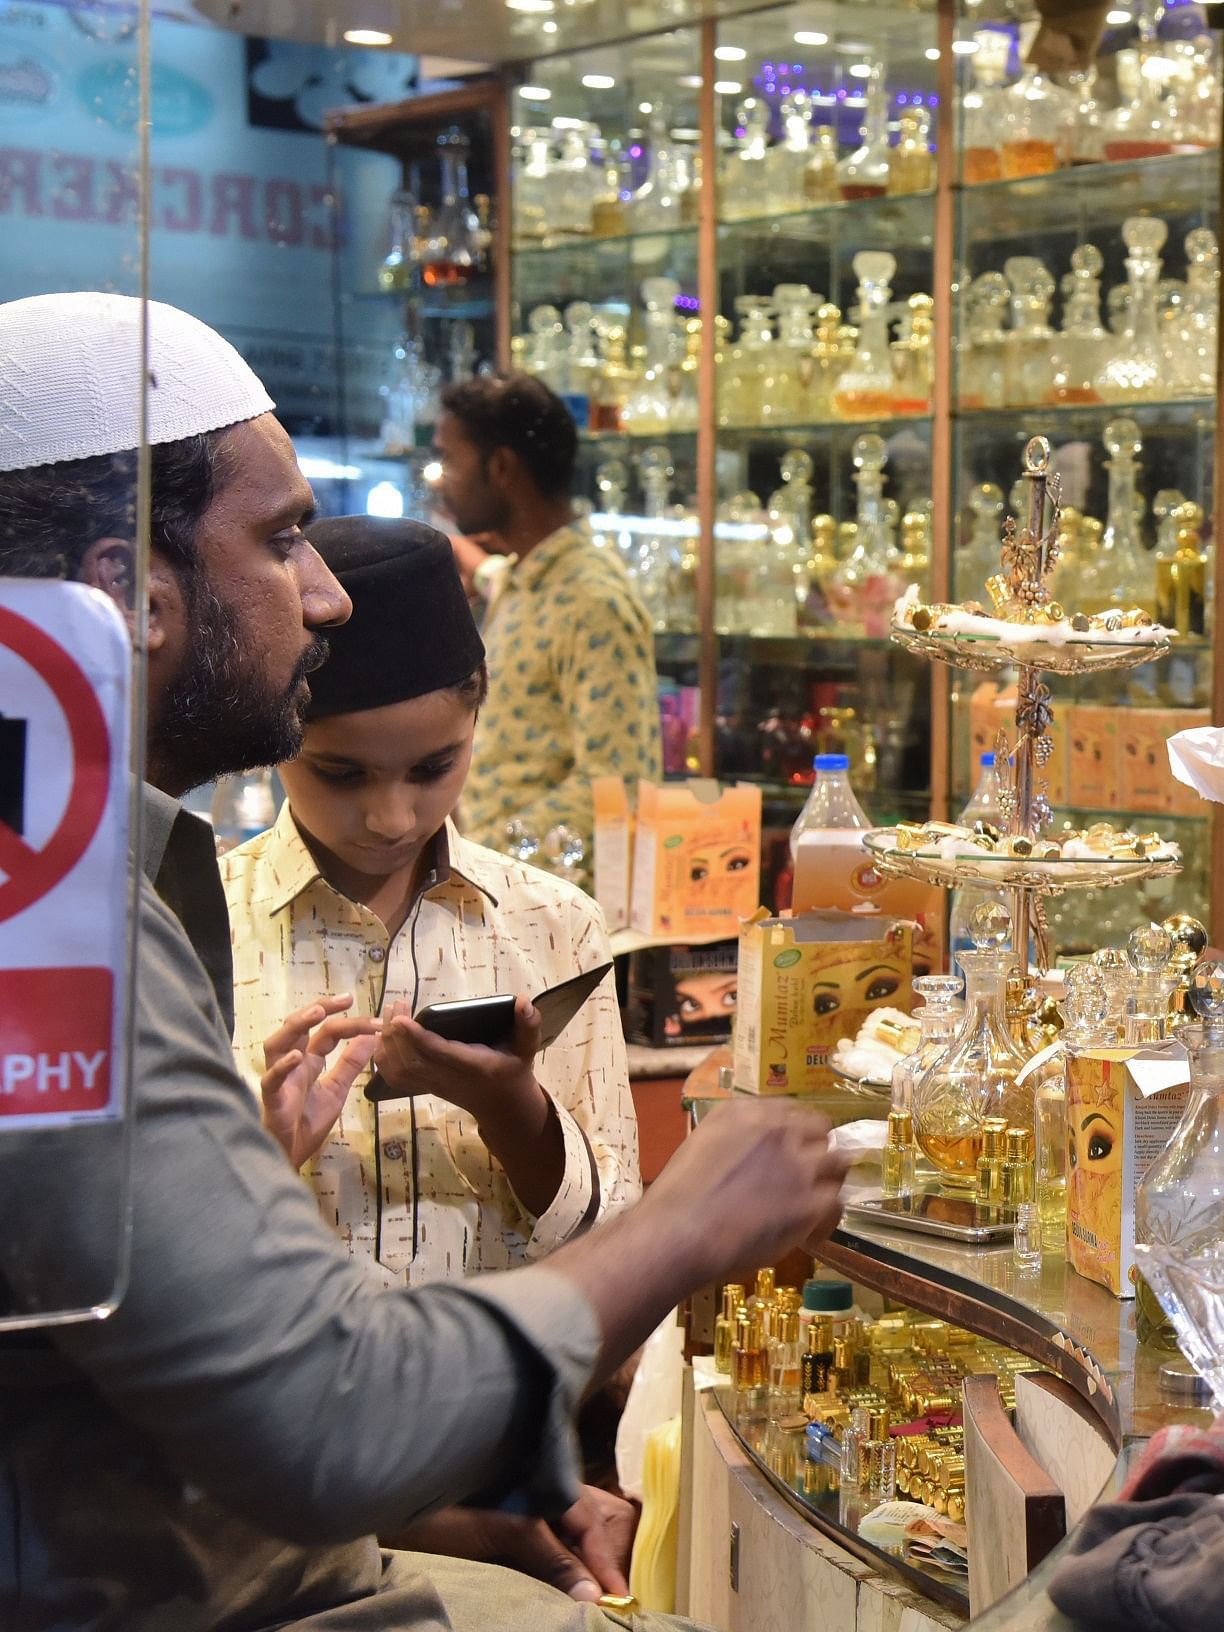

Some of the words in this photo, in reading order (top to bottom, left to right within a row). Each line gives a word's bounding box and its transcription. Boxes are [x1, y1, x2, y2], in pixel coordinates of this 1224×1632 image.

[768, 975, 789, 1060] Mumtaz
[0, 1051, 107, 1095] PHY
[1134, 1091, 1182, 1101] umtaz
